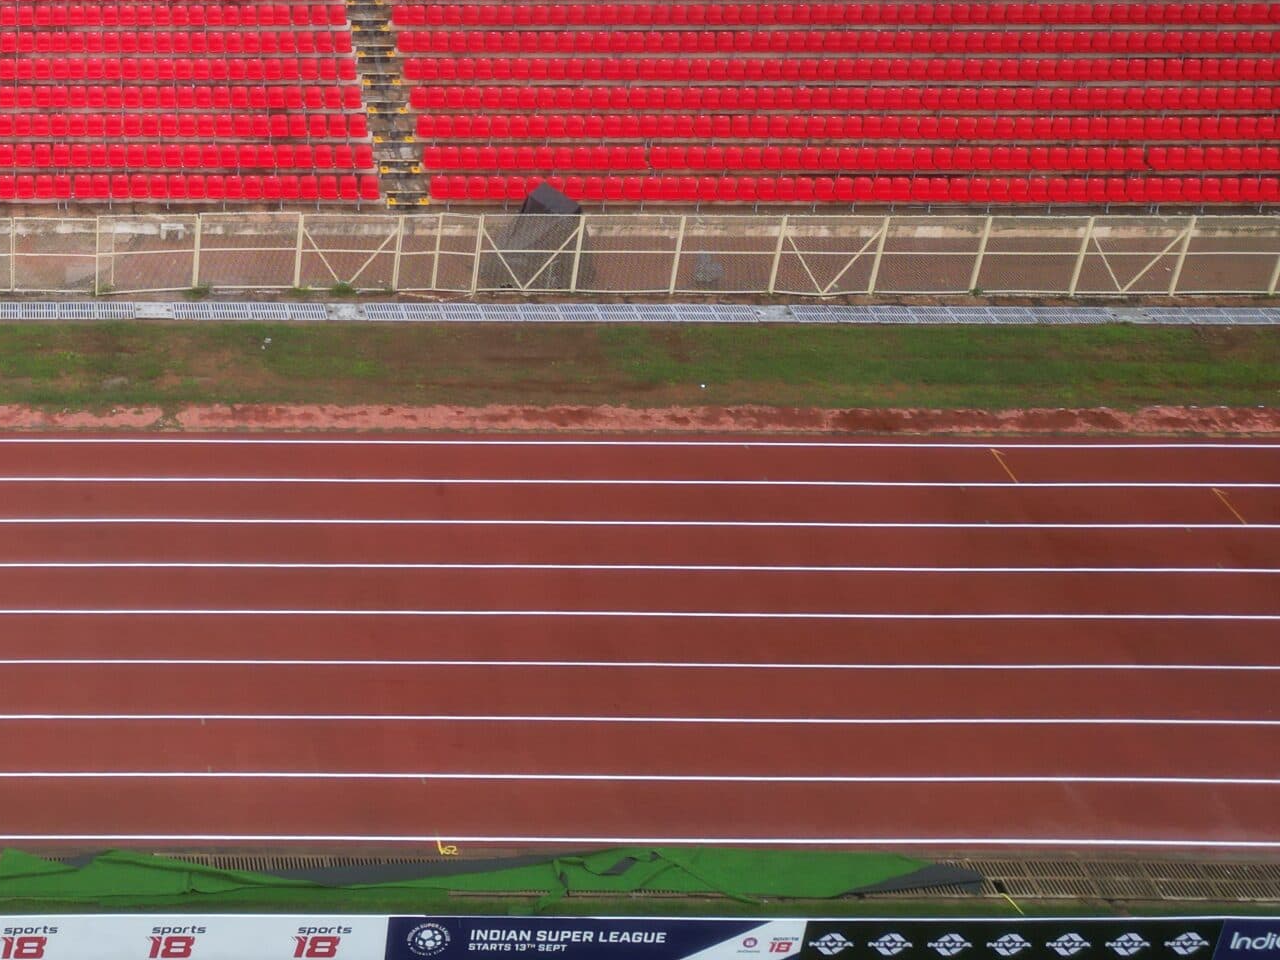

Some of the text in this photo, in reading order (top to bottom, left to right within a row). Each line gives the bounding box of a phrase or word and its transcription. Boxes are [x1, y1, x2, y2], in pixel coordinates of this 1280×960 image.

[3, 925, 58, 936] sports
[152, 925, 207, 936] sports
[297, 925, 352, 936] sports
[470, 929, 667, 943] INDIAN SUPER LEAGUE
[468, 942, 512, 951] STARTS
[538, 943, 568, 952] SEPT
[768, 941, 793, 953] 18
[1230, 931, 1280, 950] Indi
[0, 936, 48, 959] 18
[147, 936, 196, 959] 18
[291, 936, 341, 959] 18
